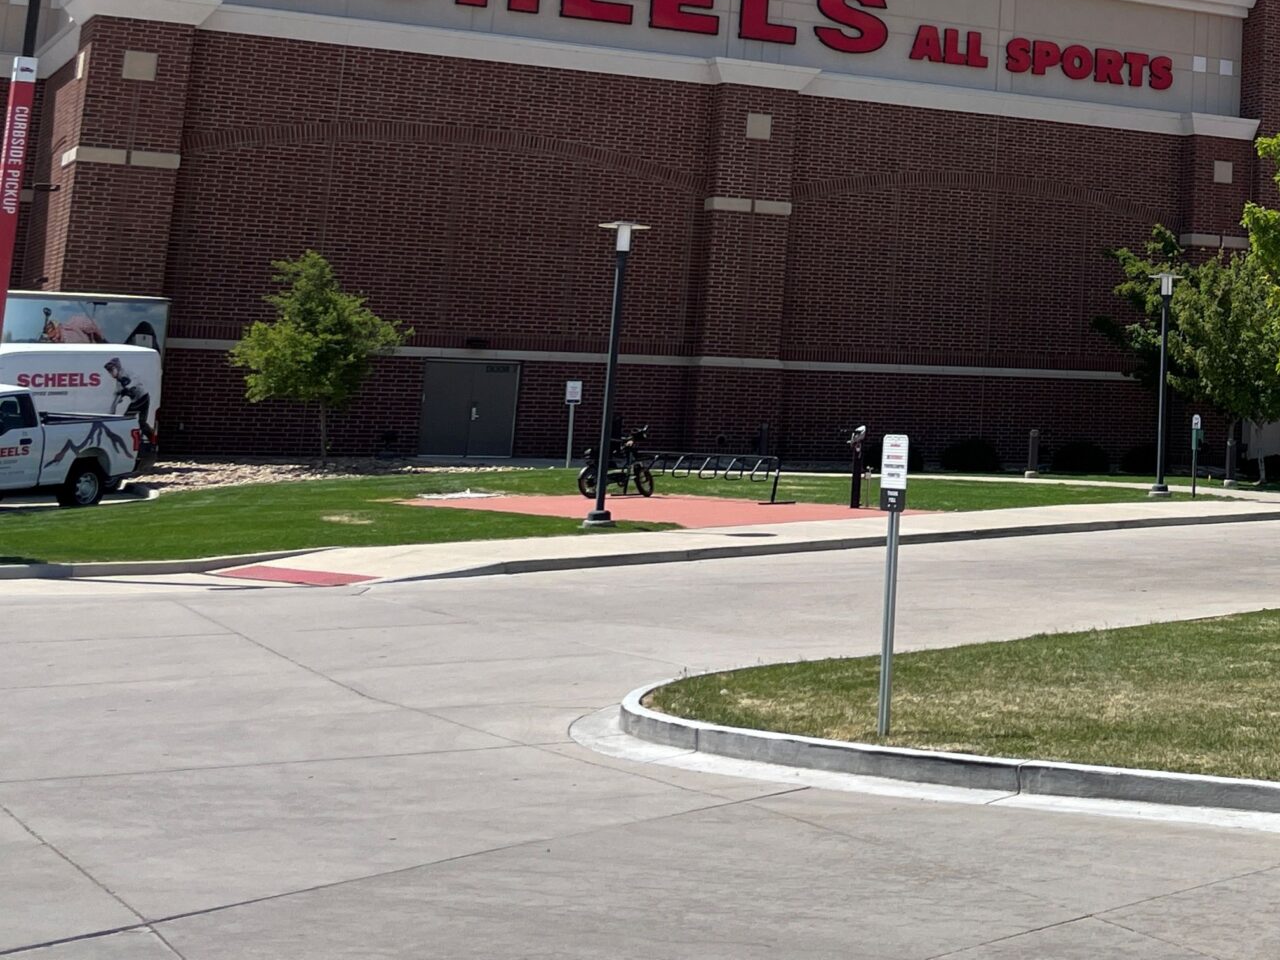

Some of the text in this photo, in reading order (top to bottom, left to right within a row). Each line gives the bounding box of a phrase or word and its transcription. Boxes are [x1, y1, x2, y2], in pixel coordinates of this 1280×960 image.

[909, 25, 1174, 90] ALL SPORTS
[3, 106, 29, 214] CURBSIDE PICKUP
[17, 373, 101, 388] SCHEELS
[0, 446, 30, 457] EELS
